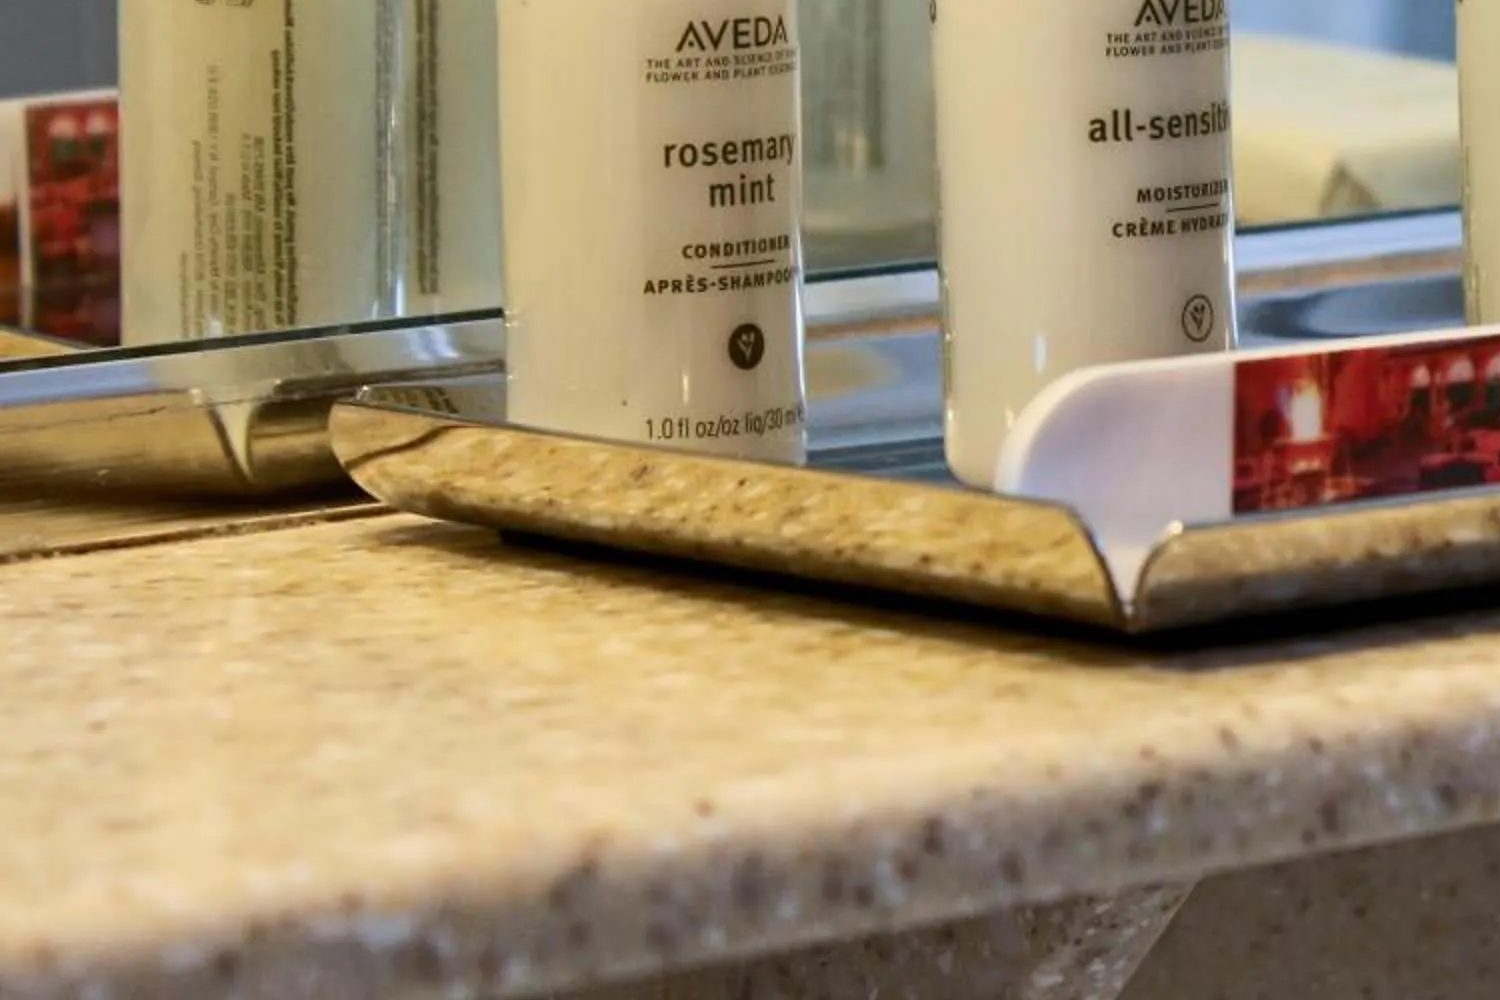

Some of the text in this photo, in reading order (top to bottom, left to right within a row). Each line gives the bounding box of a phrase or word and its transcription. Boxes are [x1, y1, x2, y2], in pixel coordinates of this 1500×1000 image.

[674, 14, 788, 52] AVEDA
[1106, 31, 1130, 44] THE
[1134, 30, 1158, 43] ART
[1161, 29, 1183, 42] AND
[645, 71, 699, 83] FLOWER
[704, 69, 729, 81] AND
[647, 58, 671, 70] THE
[676, 57, 701, 69] ART
[705, 55, 730, 68] AND
[1088, 101, 1230, 143] all-sensiti
[663, 133, 795, 169] rosemary
[708, 172, 776, 208] mint
[1111, 217, 1177, 238] CRÈME
[681, 233, 790, 260] CONDITIONER
[643, 267, 799, 295] APRÈS-SHAMPOO
[645, 417, 674, 440] 1.0
[677, 417, 690, 439] fl
[695, 414, 741, 439] oz/oz
